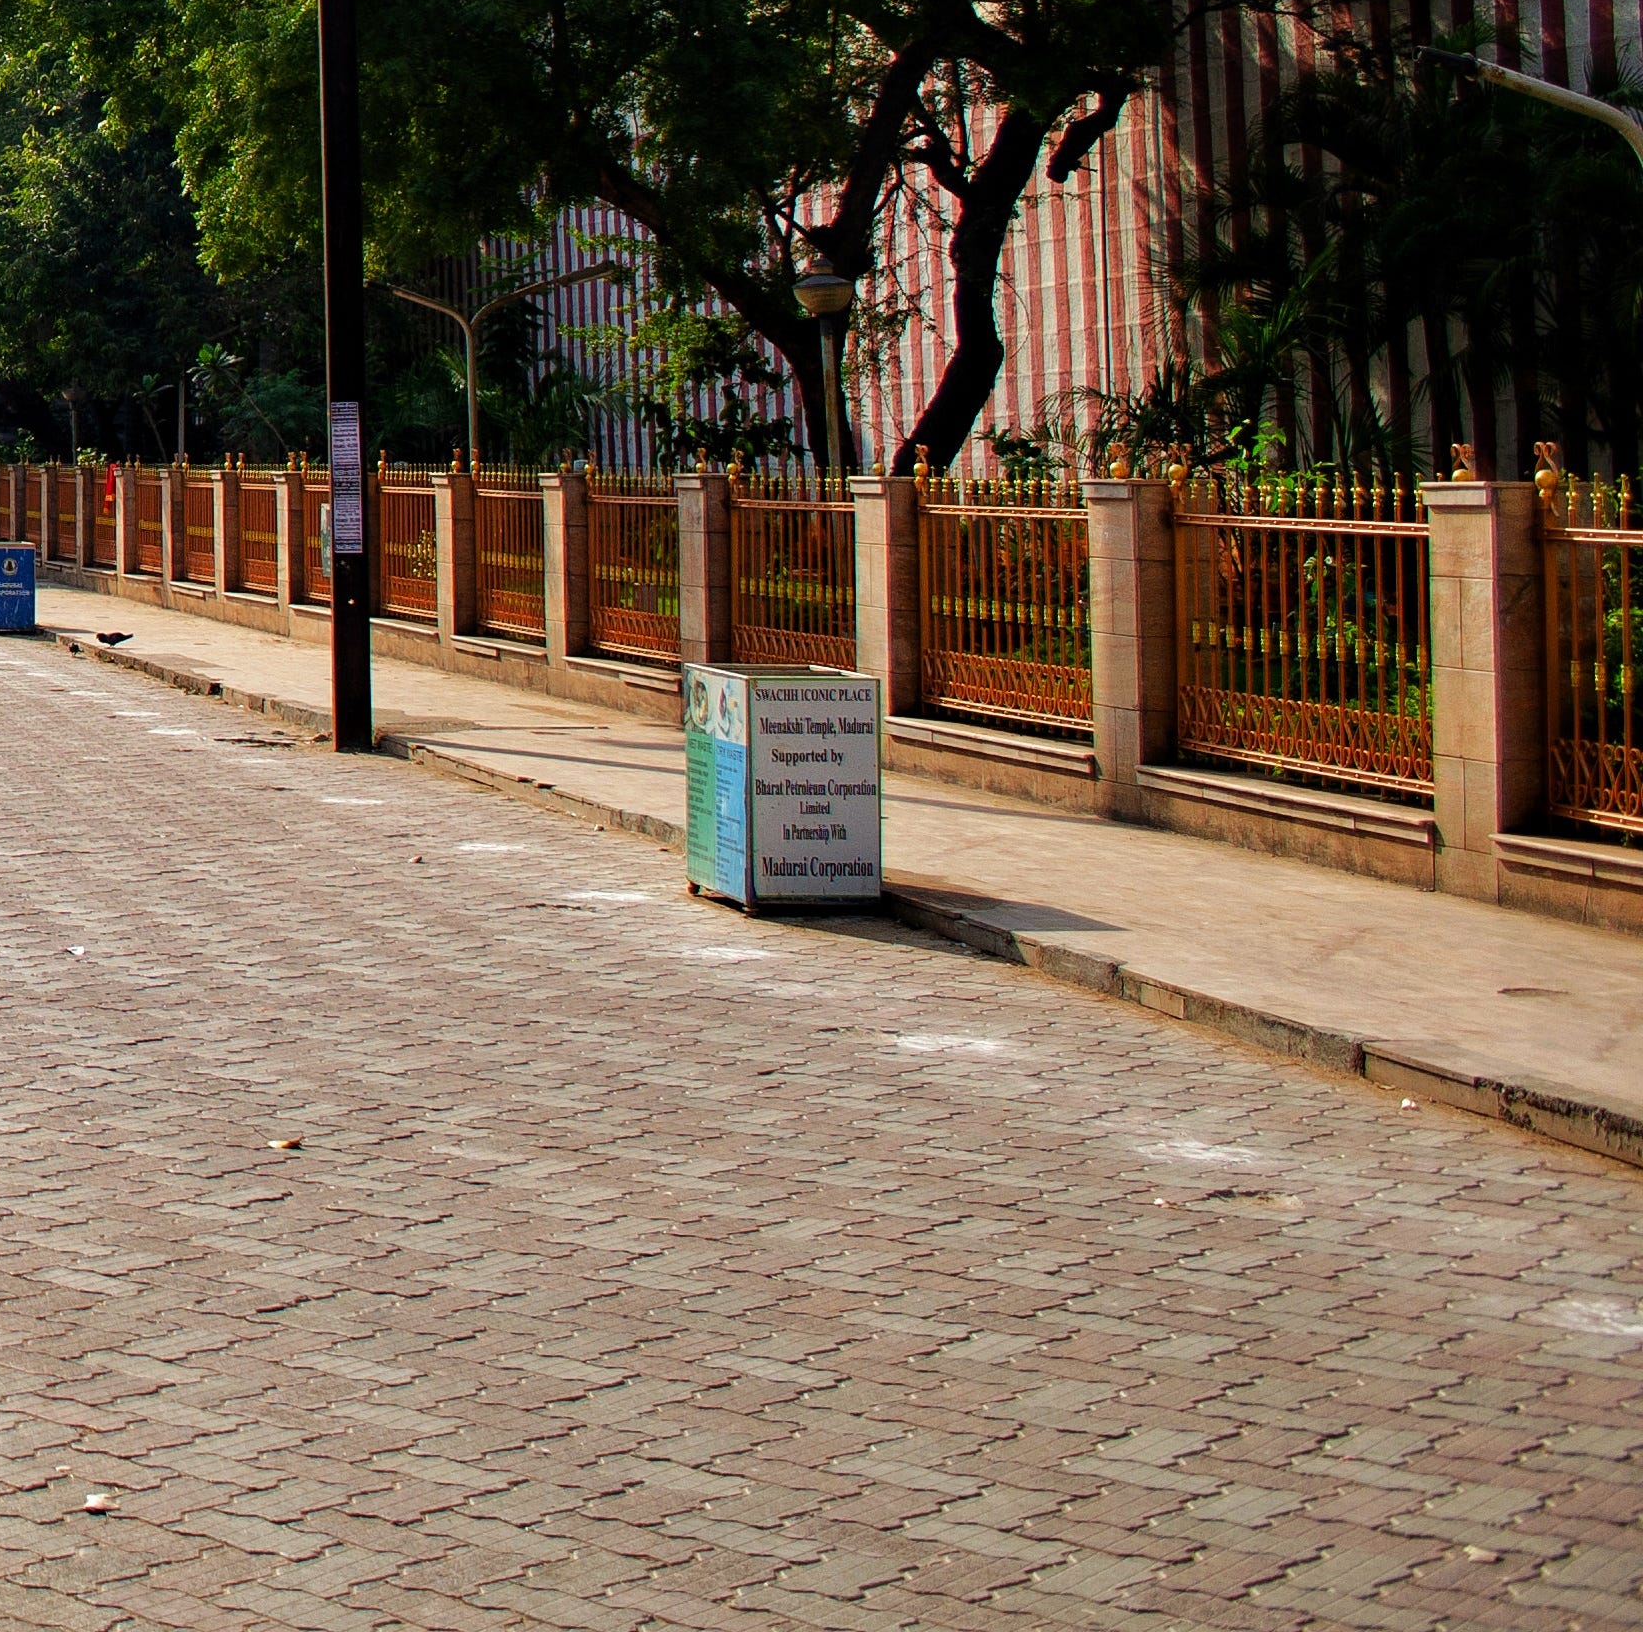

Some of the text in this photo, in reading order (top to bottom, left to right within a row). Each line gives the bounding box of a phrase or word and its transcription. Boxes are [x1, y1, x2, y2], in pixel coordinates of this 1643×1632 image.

[755, 688, 872, 702] SWACHH ICONIC PLACE
[760, 717, 874, 739] Meenakshi Temple, Madurai
[771, 748, 844, 766] Supported by
[755, 779, 877, 800] Bharat Petroleum Corporation
[800, 801, 830, 814] Limited
[782, 823, 847, 845] In Partnership With
[762, 856, 874, 882] Madurai Corporation
